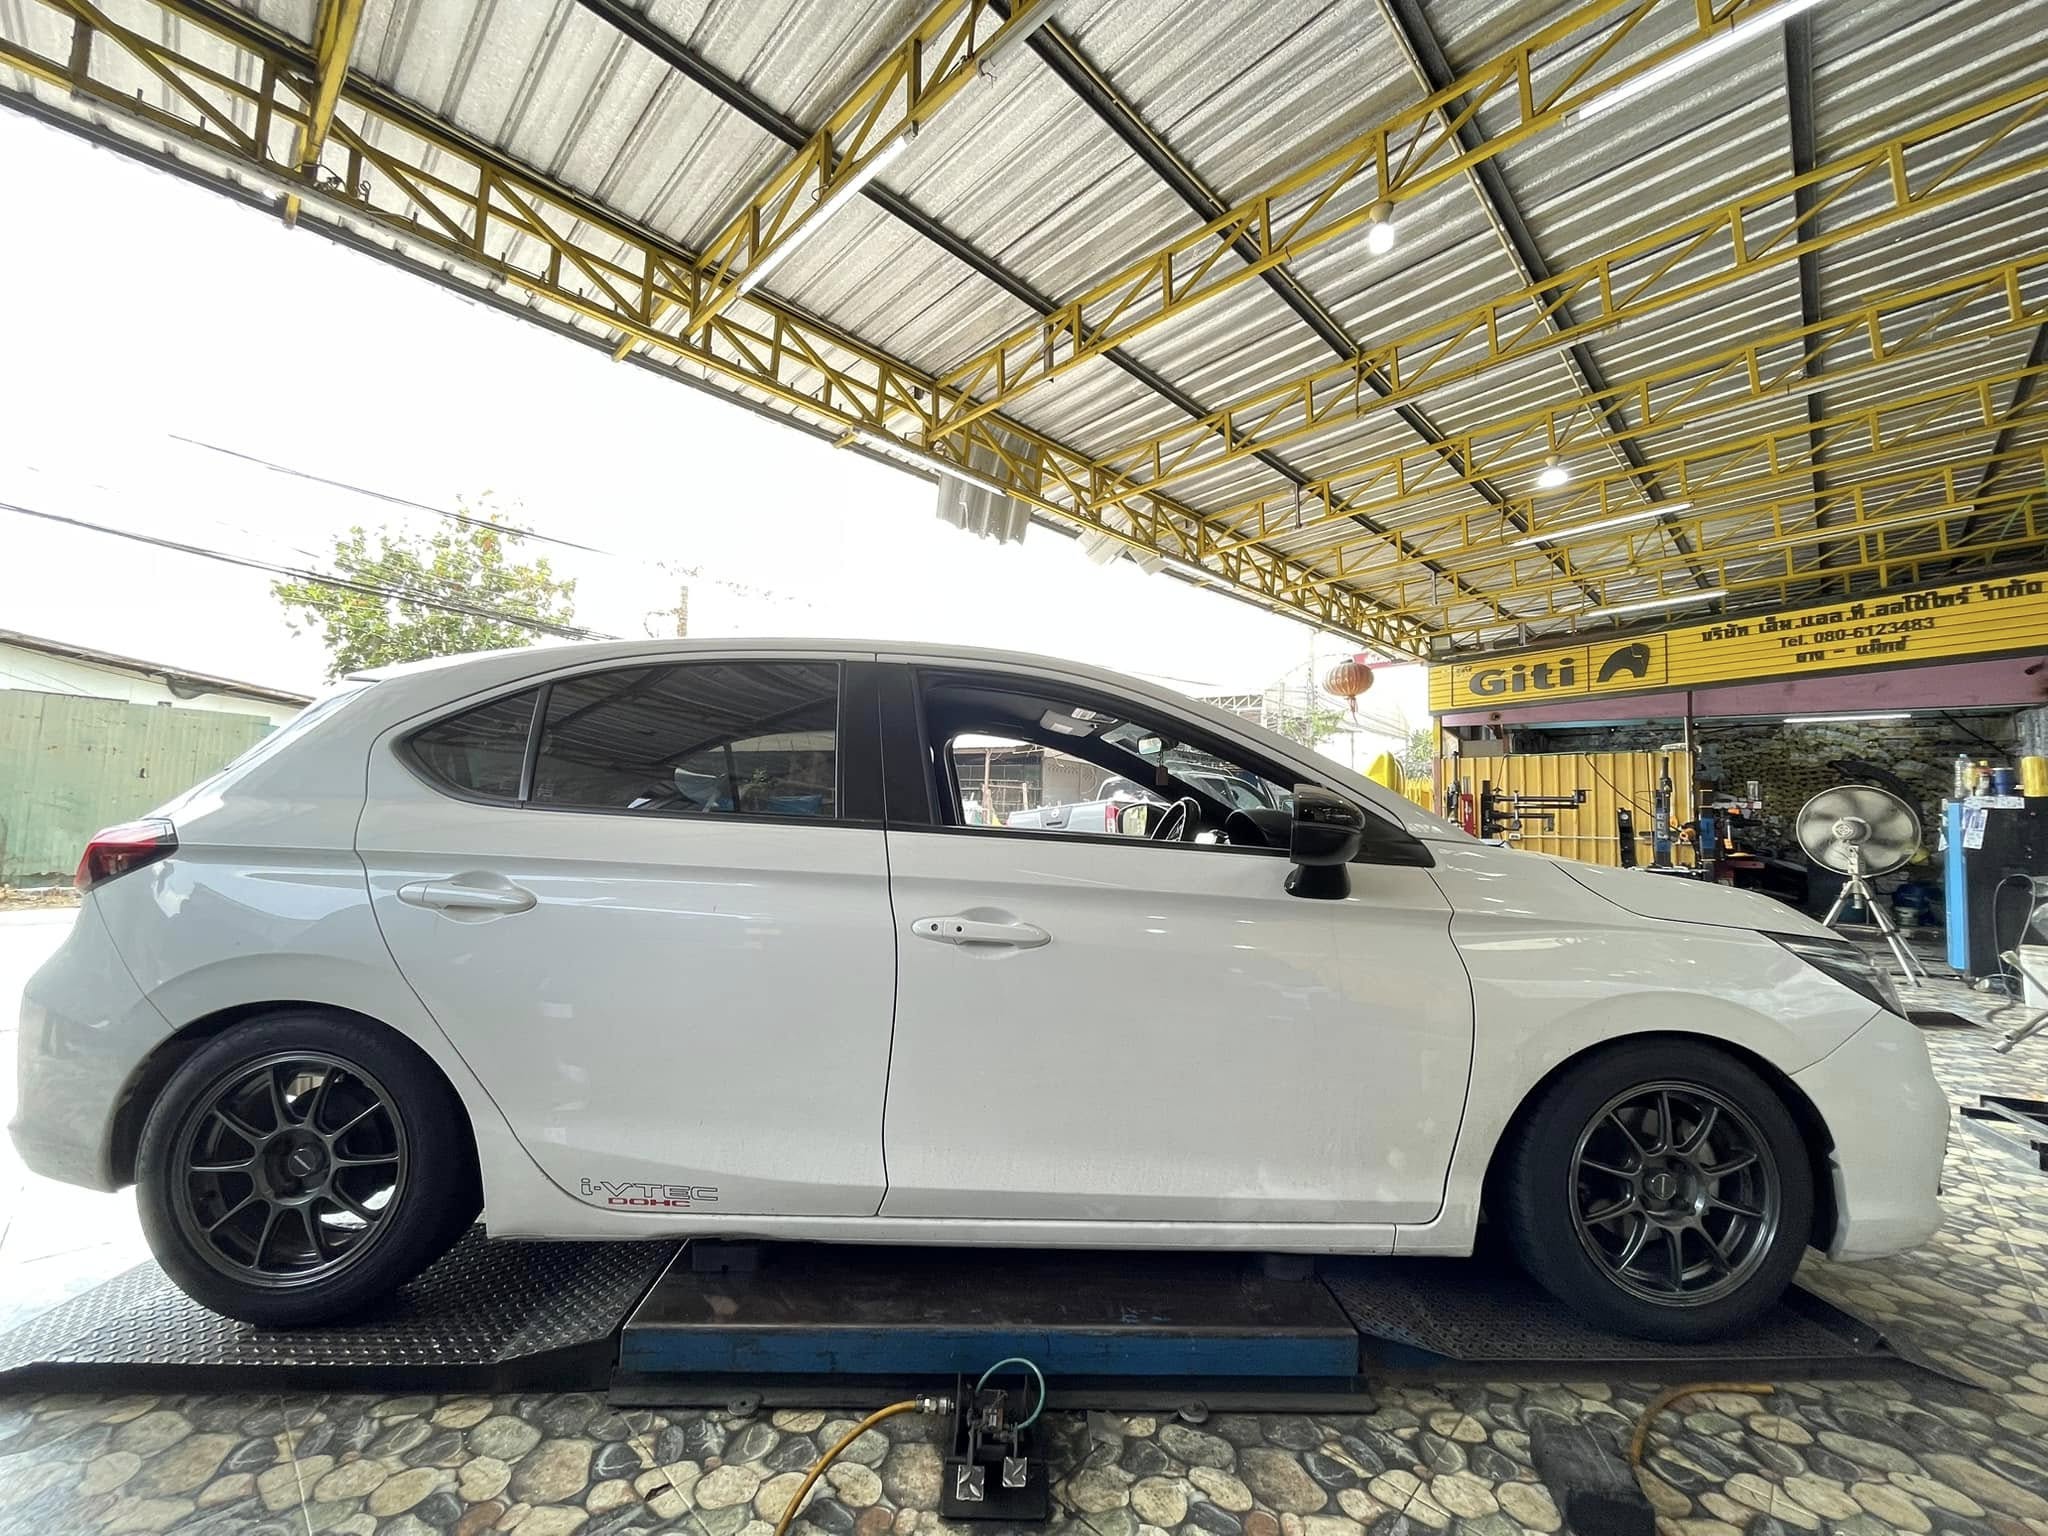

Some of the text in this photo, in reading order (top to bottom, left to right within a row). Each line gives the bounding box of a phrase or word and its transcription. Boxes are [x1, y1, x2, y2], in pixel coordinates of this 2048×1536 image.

[1779, 617, 1936, 648] Tel. 080-6123483
[1469, 657, 1575, 697] Giti
[580, 1177, 719, 1202] i-VTEC
[607, 1197, 691, 1208] DOHC
